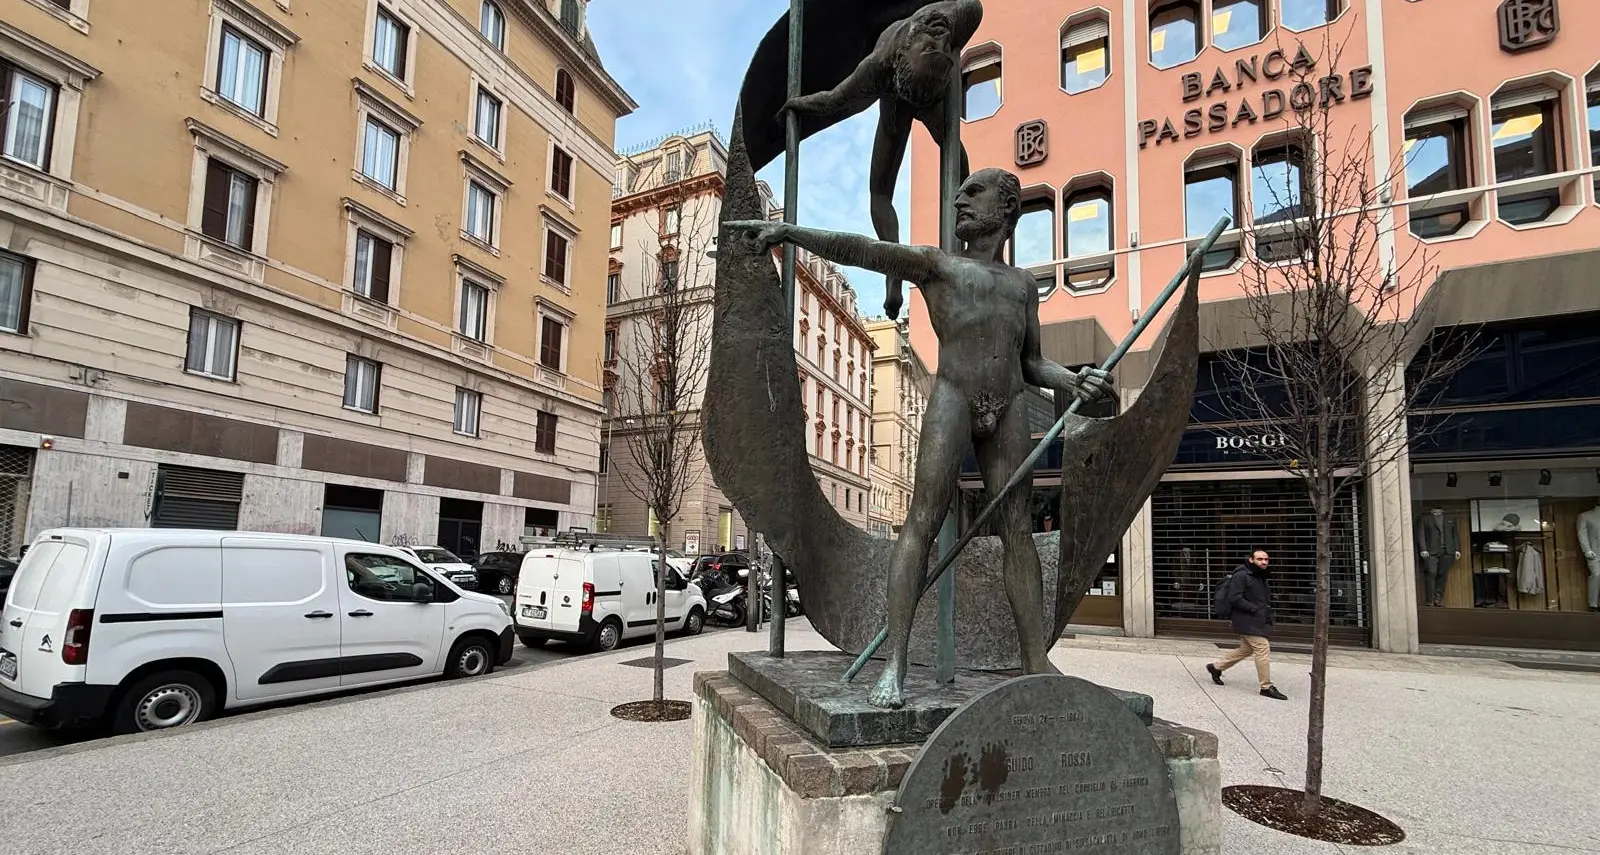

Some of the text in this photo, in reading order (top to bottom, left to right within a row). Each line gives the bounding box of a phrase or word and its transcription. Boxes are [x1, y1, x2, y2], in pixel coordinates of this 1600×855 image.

[1181, 43, 1316, 102] BANCA
[1138, 65, 1374, 149] PASSADORE
[147, 472, 156, 510] TICKET
[1005, 752, 1092, 773] GUIDO ROSSA
[1058, 784, 1071, 796] DEL
[968, 822, 987, 835] EBBE
